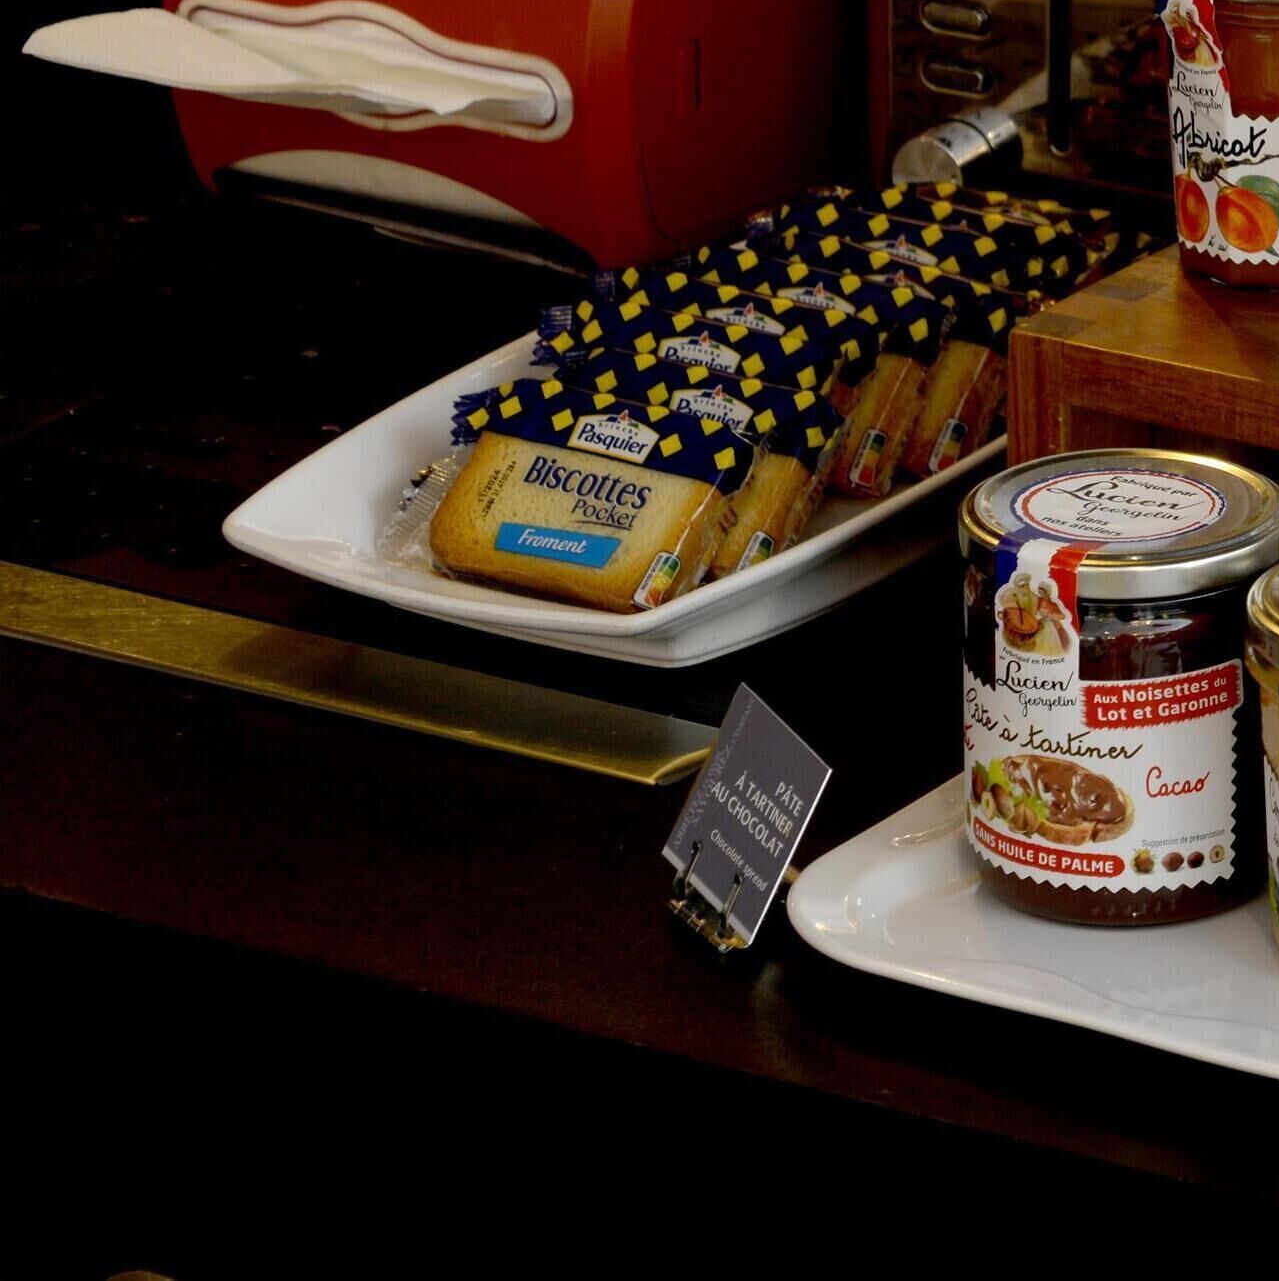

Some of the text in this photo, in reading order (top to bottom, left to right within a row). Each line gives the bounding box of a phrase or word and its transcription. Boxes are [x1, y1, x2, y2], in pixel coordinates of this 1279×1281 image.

[1172, 71, 1219, 97] Lucien
[1173, 106, 1267, 169] Abricot
[577, 423, 649, 456] Pasquier
[523, 455, 652, 510] Biscottes
[1047, 481, 1206, 511] Lucien
[1110, 474, 1199, 498] Fabriqué par
[571, 499, 638, 529] Pocket
[1076, 515, 1110, 527] dans
[1081, 500, 1186, 521] Georgelin
[517, 528, 587, 554] Froment
[1042, 516, 1124, 537] nos ateliers
[1003, 647, 1030, 663] Fabriqué
[1042, 657, 1065, 665] France
[996, 660, 1074, 694] Lucien
[1094, 676, 1227, 705] Aux Noisettes du
[1019, 693, 1077, 717] Georgelin
[1098, 690, 1228, 721] Lot et Garonne
[999, 714, 1018, 742] à
[1020, 725, 1144, 760] tartiner
[1146, 765, 1210, 799] Cacao
[734, 770, 795, 839] À TARTINER
[775, 781, 804, 818] PÂTE
[710, 782, 728, 803] AU
[727, 796, 785, 859] CHOCOLAT
[974, 823, 1114, 874] SANS HUILE DE PALME
[1141, 829, 1226, 849] Suggestion de présentation
[710, 829, 770, 893] Chocolate spread
